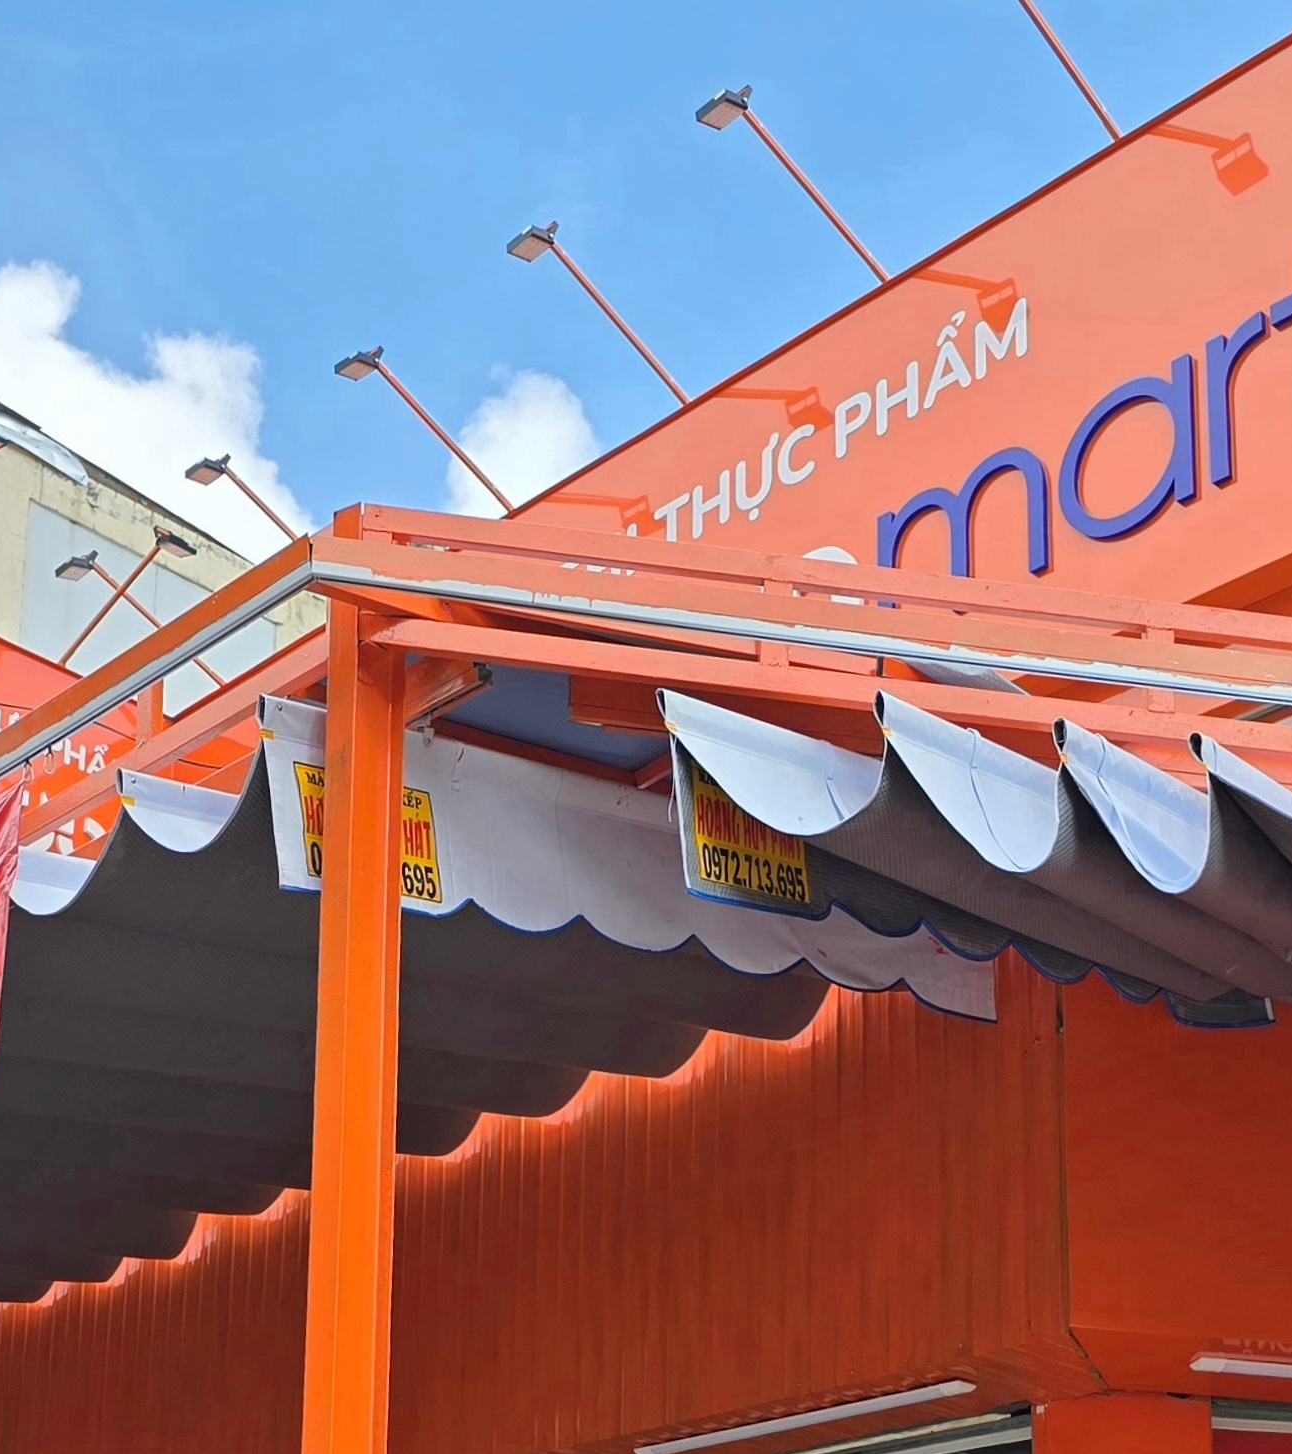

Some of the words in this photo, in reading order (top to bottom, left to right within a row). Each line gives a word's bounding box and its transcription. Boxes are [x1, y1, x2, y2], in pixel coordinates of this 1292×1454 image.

[653, 423, 816, 542] THỰC
[834, 297, 1029, 458] PHẨM
[701, 842, 806, 901] 0972.713.695
